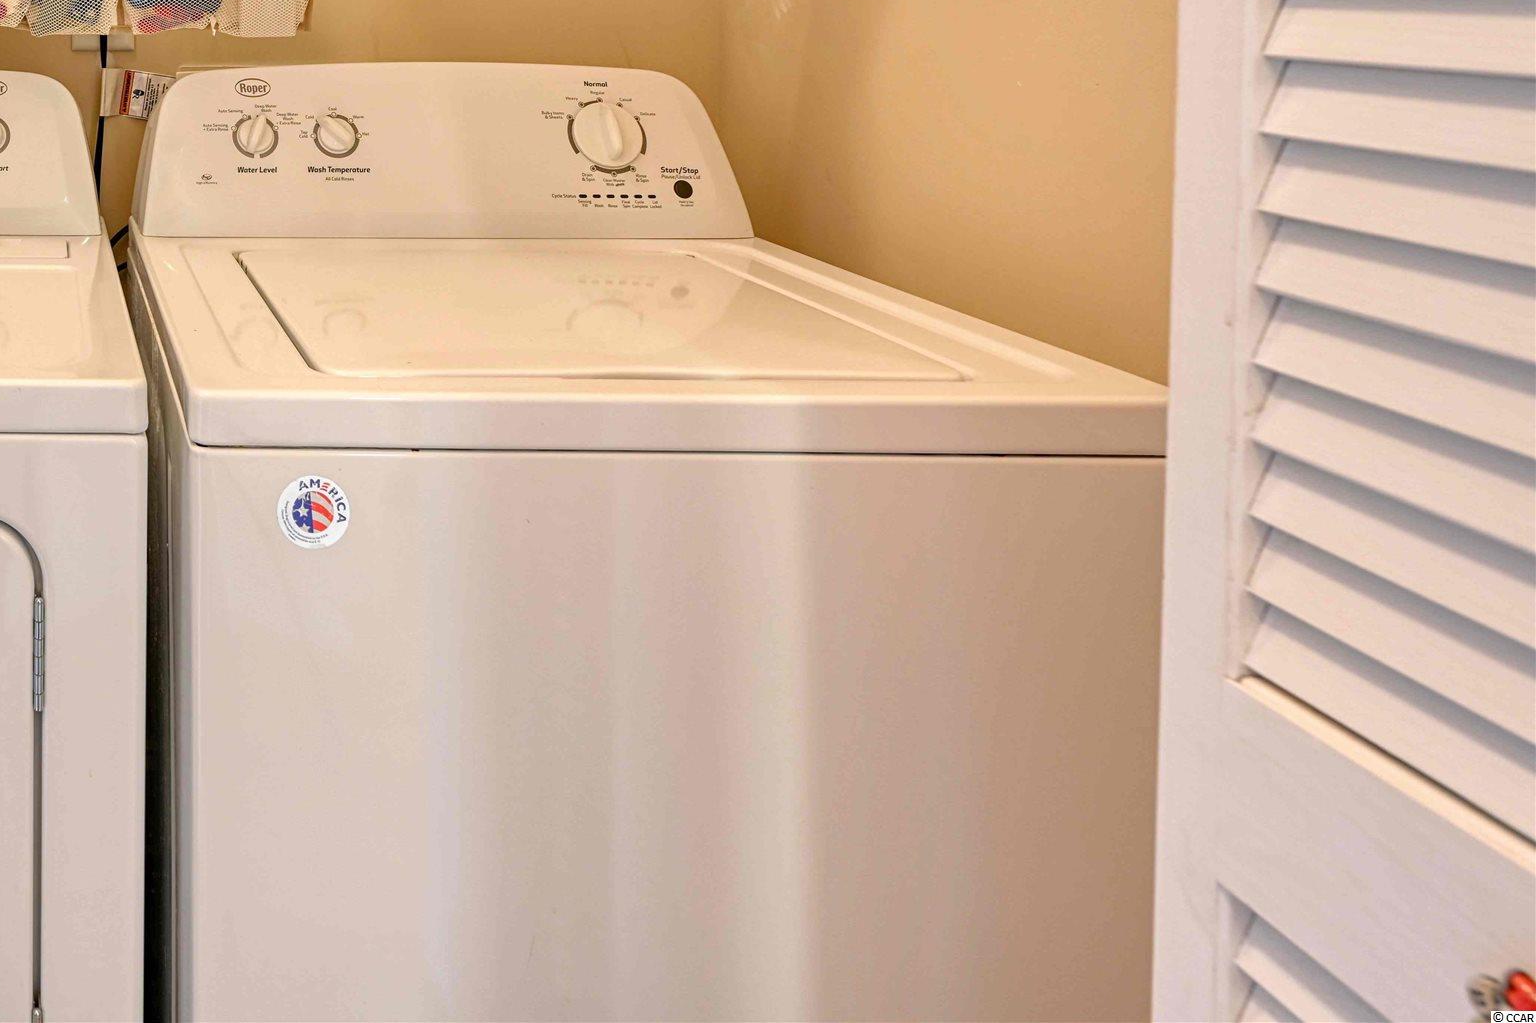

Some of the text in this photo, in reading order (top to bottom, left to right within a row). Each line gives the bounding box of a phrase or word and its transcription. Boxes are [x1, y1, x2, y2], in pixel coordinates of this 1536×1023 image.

[240, 82, 268, 95] Roper
[237, 166, 277, 174] Water Level
[308, 166, 371, 176] Wash Temperature
[660, 166, 699, 175] Start/Stop
[299, 479, 347, 524] AMERICA
